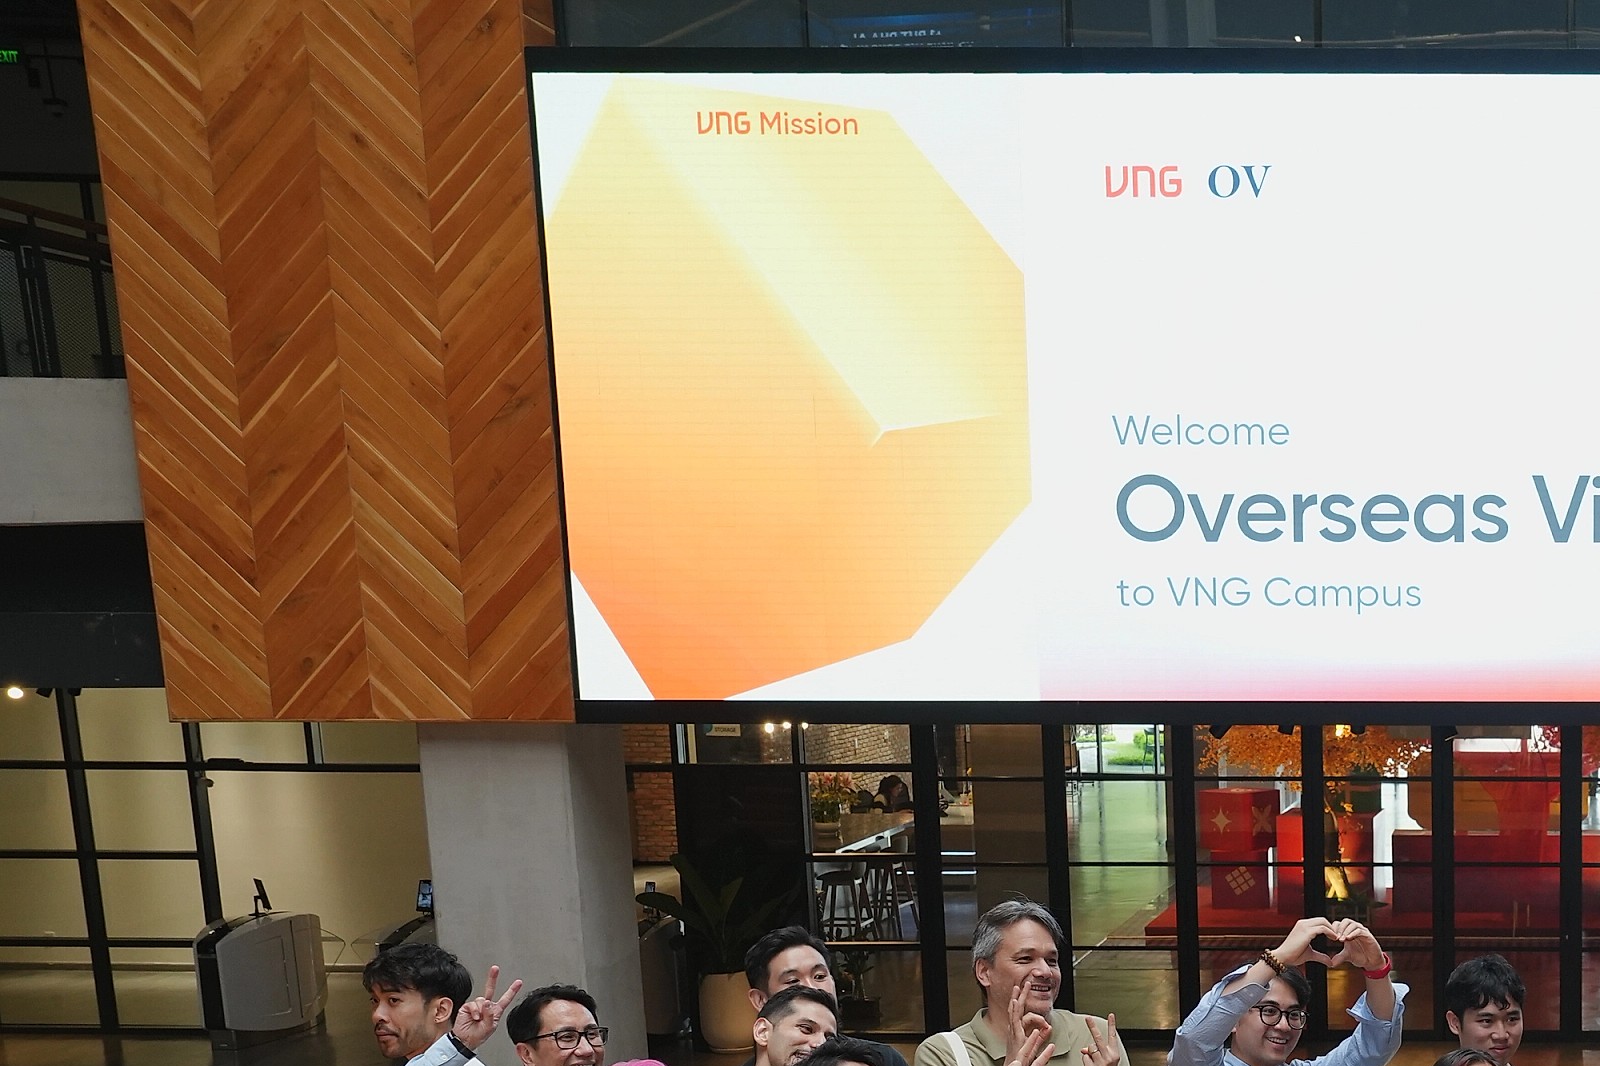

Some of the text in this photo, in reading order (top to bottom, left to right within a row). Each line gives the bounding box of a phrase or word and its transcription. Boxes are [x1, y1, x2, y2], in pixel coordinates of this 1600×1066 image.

[697, 111, 859, 136] VNG Mission
[1105, 164, 1272, 199] VNG OV
[1112, 414, 1291, 447] Welcome
[1116, 474, 1510, 544] Overseas
[1116, 576, 1423, 616] to VNG Campus
